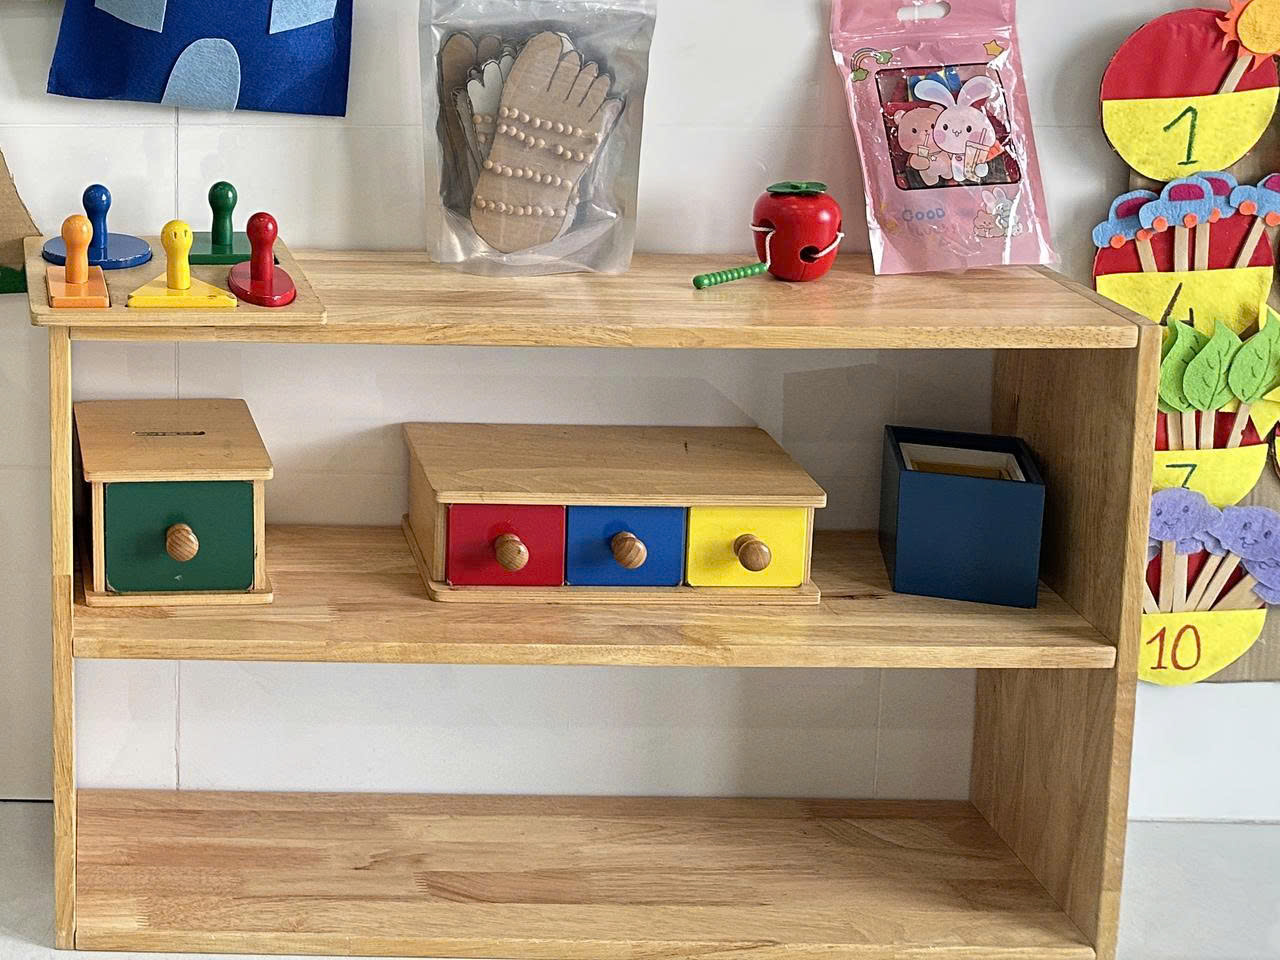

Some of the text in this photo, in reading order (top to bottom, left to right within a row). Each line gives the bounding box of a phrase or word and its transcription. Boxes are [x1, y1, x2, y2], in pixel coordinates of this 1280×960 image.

[1163, 105, 1199, 166] 1
[902, 208, 946, 222] GOOD
[1146, 624, 1202, 672] 10
